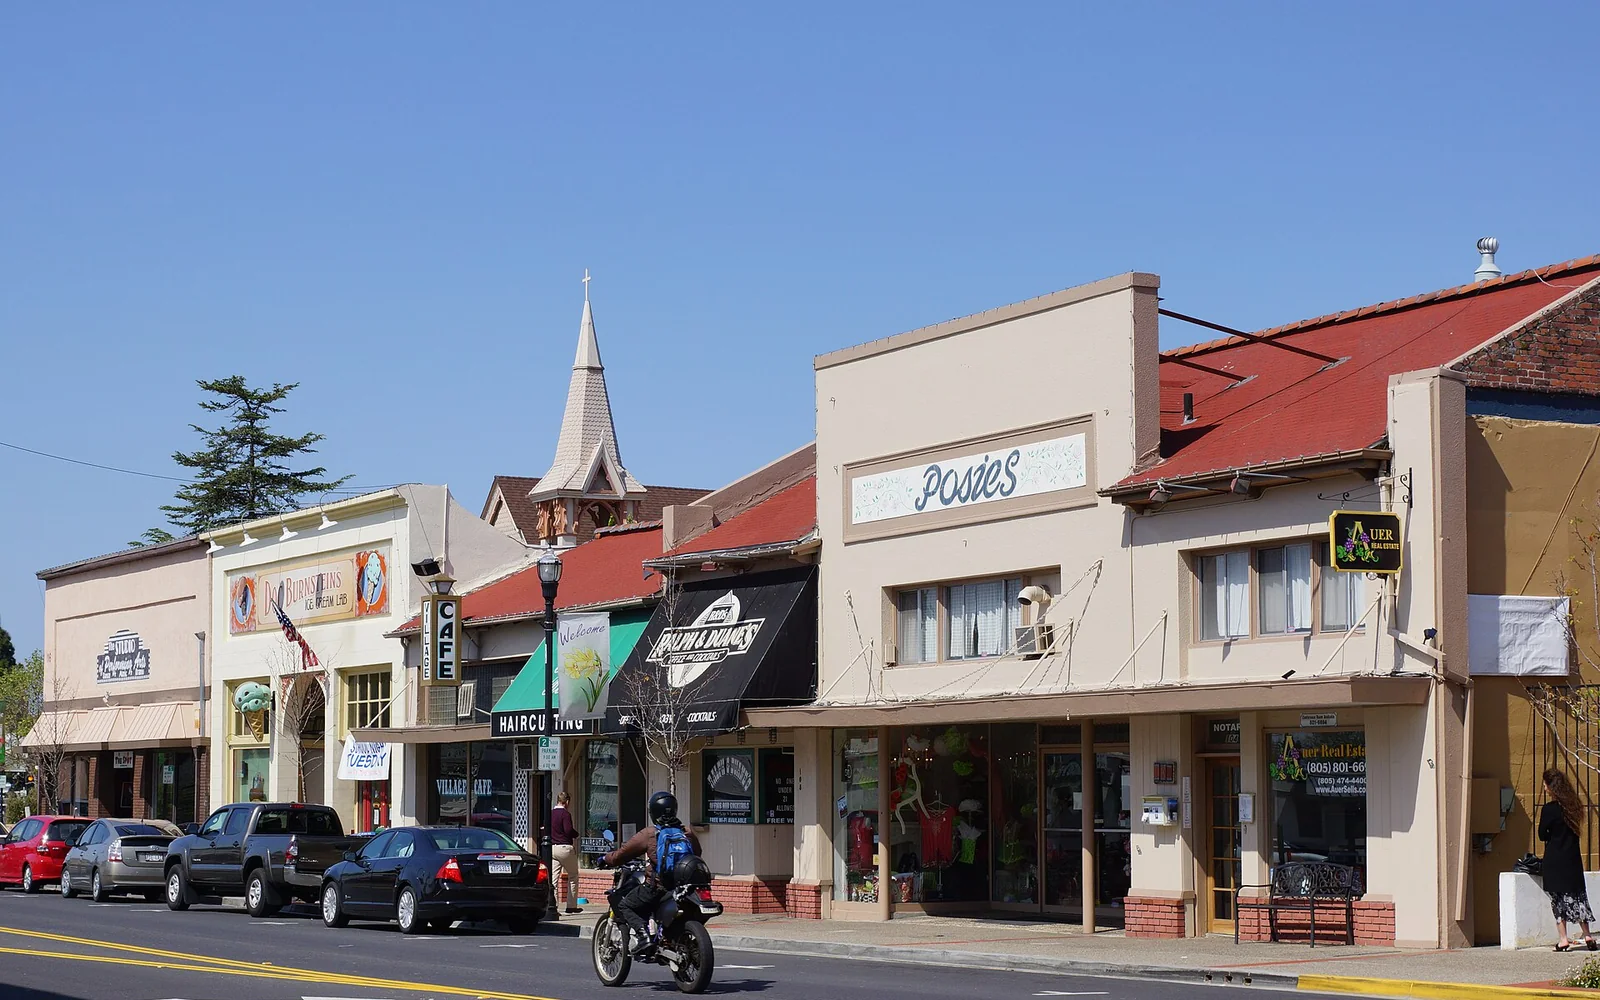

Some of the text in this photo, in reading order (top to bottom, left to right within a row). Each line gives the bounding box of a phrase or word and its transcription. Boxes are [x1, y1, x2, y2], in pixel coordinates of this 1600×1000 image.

[305, 592, 348, 611] ICE CREAM LAB
[439, 602, 453, 678] CAFE
[560, 624, 606, 646] Welcome
[651, 622, 759, 658] RALPH & DUANE'S
[114, 638, 136, 656] STUDIO
[500, 713, 583, 733] HAIRCUTING
[542, 738, 547, 746] 2
[1321, 744, 1344, 757] Real
[1346, 744, 1366, 757] Esta
[1307, 762, 1366, 774] (805) 801-66
[436, 779, 492, 795] VILLAGE CAFE
[1315, 786, 1366, 794] www.AuerSells.co
